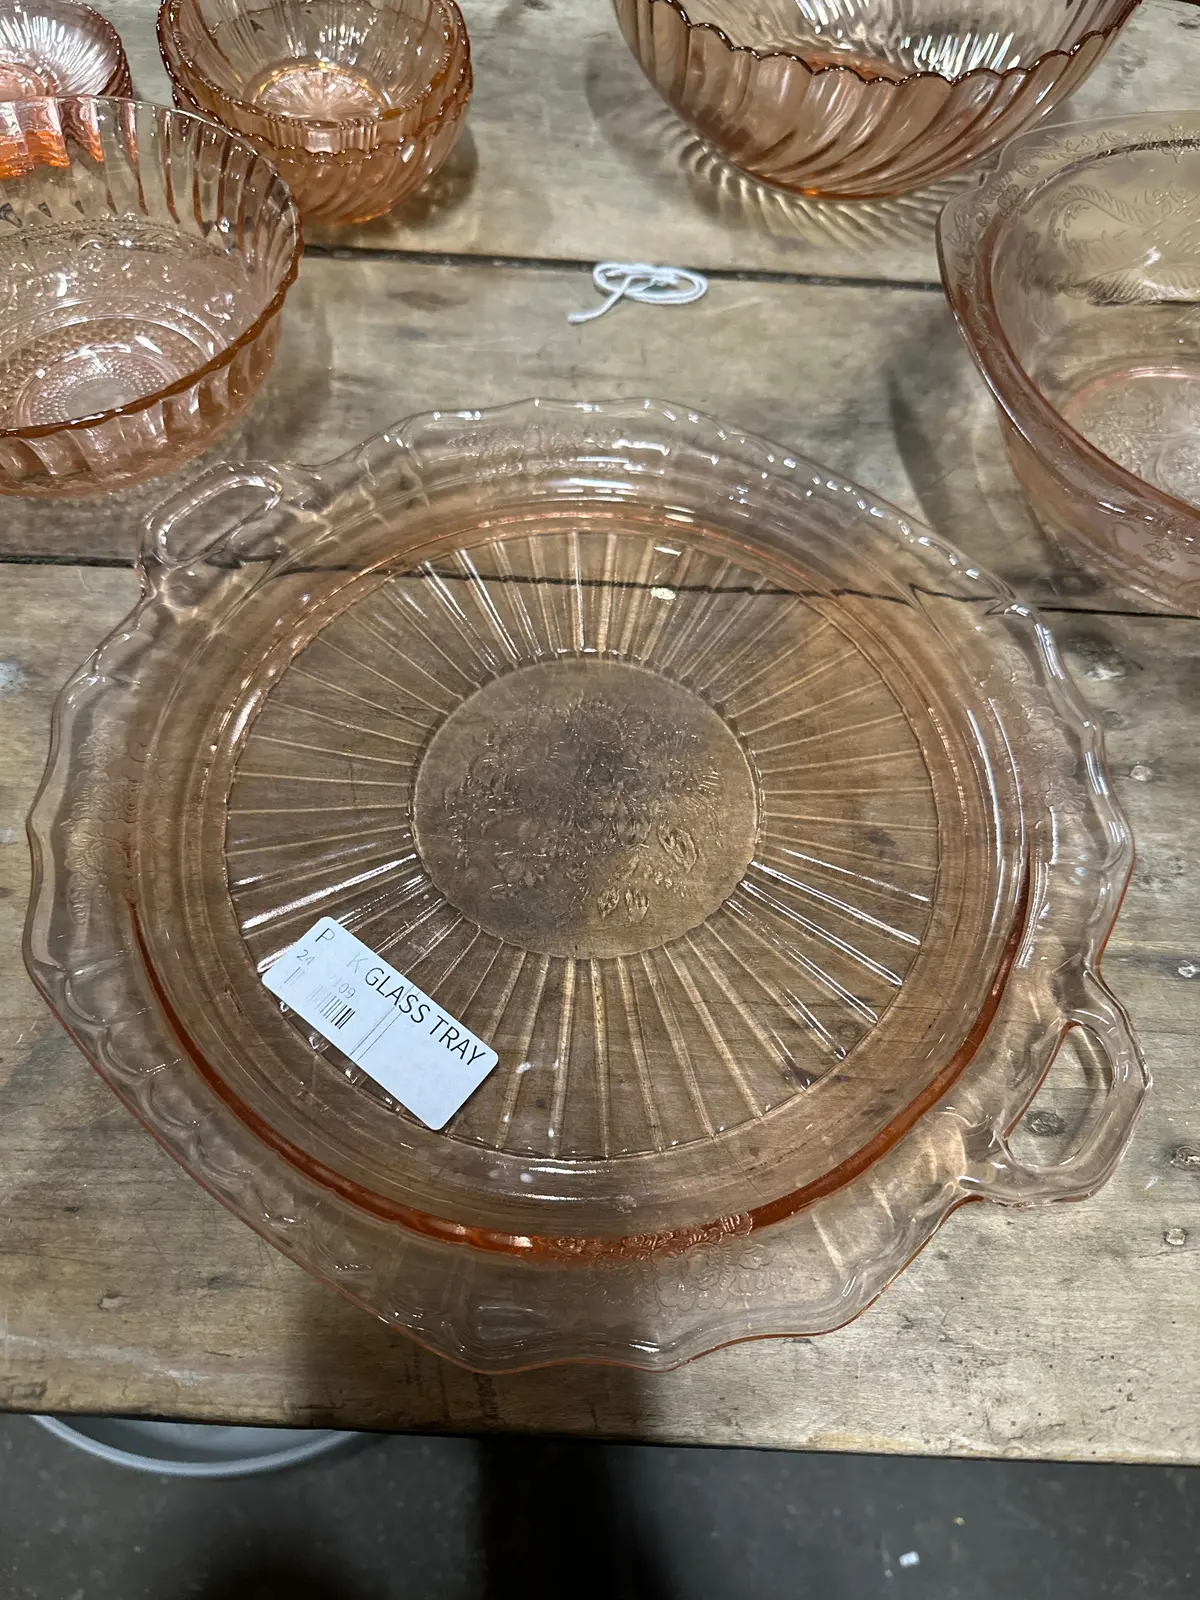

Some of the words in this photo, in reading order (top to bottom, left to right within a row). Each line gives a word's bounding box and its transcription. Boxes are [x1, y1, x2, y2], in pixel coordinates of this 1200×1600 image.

[315, 927, 369, 974] PK
[364, 967, 431, 1024] GLASS
[429, 1014, 486, 1066] TRAY
